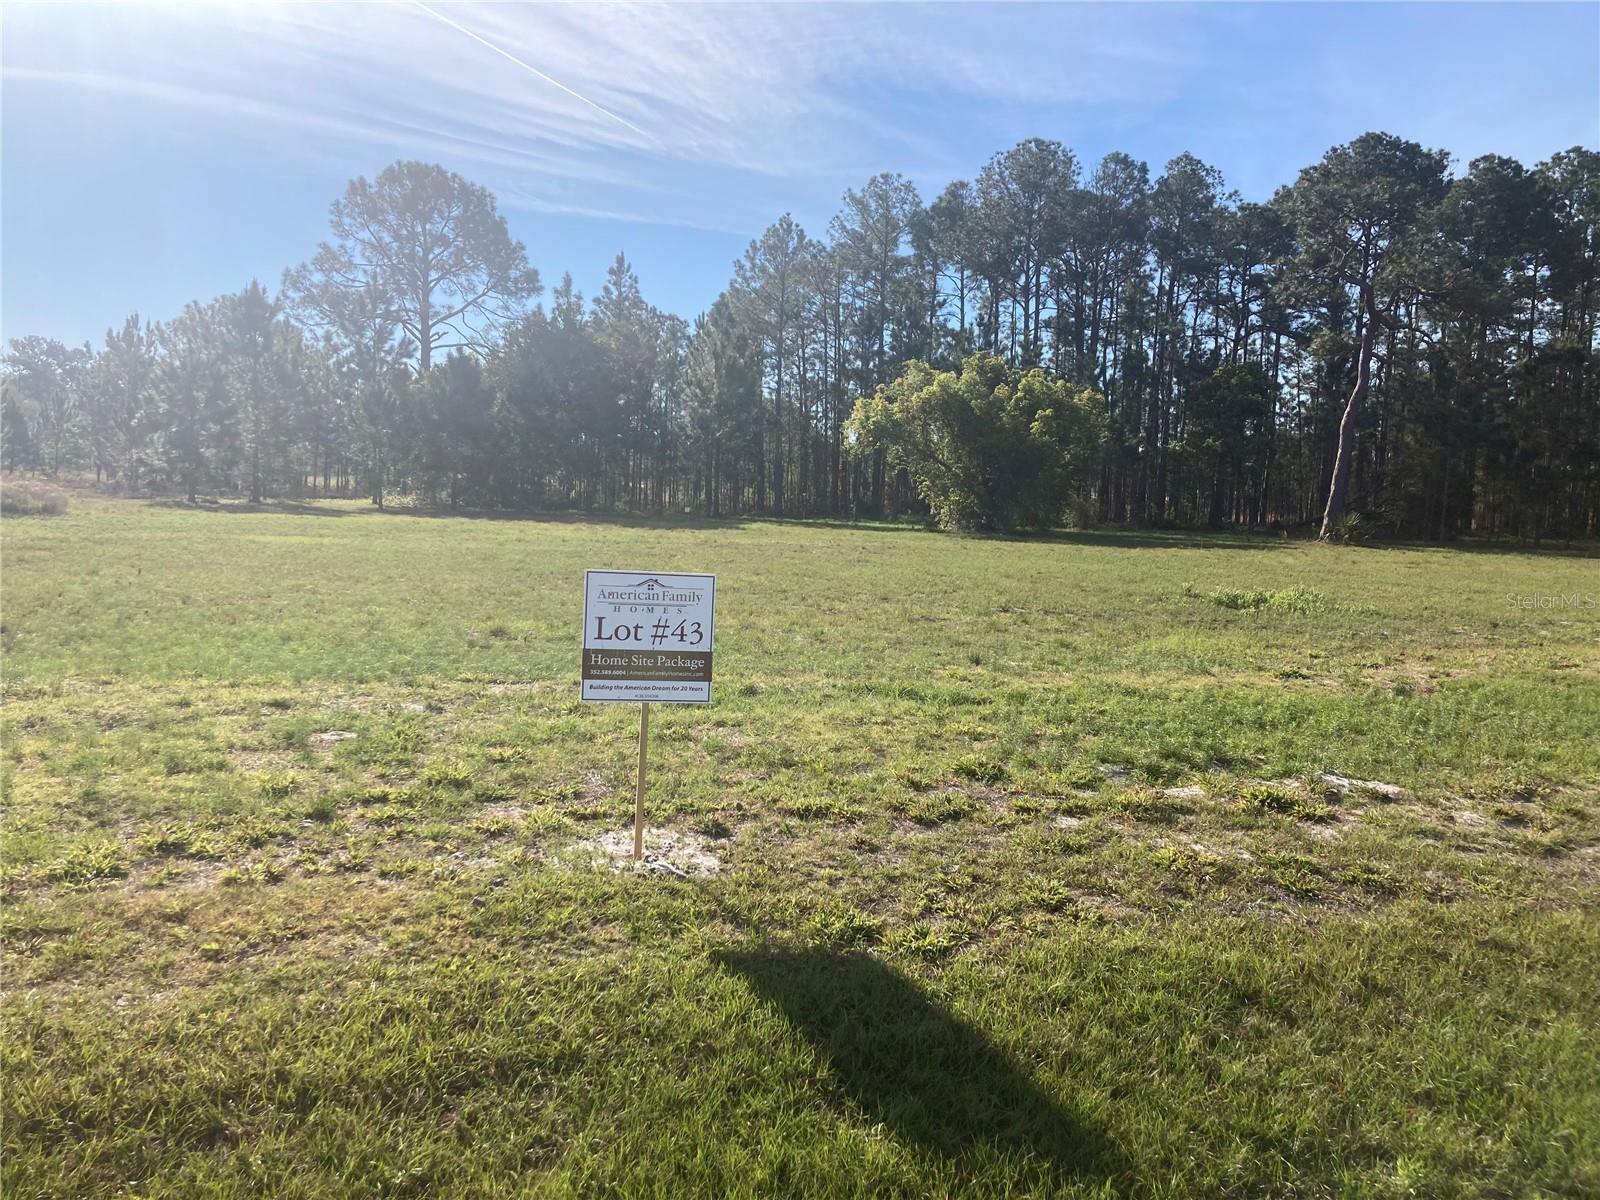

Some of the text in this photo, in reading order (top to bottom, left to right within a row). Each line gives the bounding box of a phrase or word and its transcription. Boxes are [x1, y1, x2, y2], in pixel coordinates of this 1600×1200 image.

[597, 588, 703, 603] American Family
[594, 616, 704, 645] Lot #43
[590, 654, 705, 670] Home Site Package
